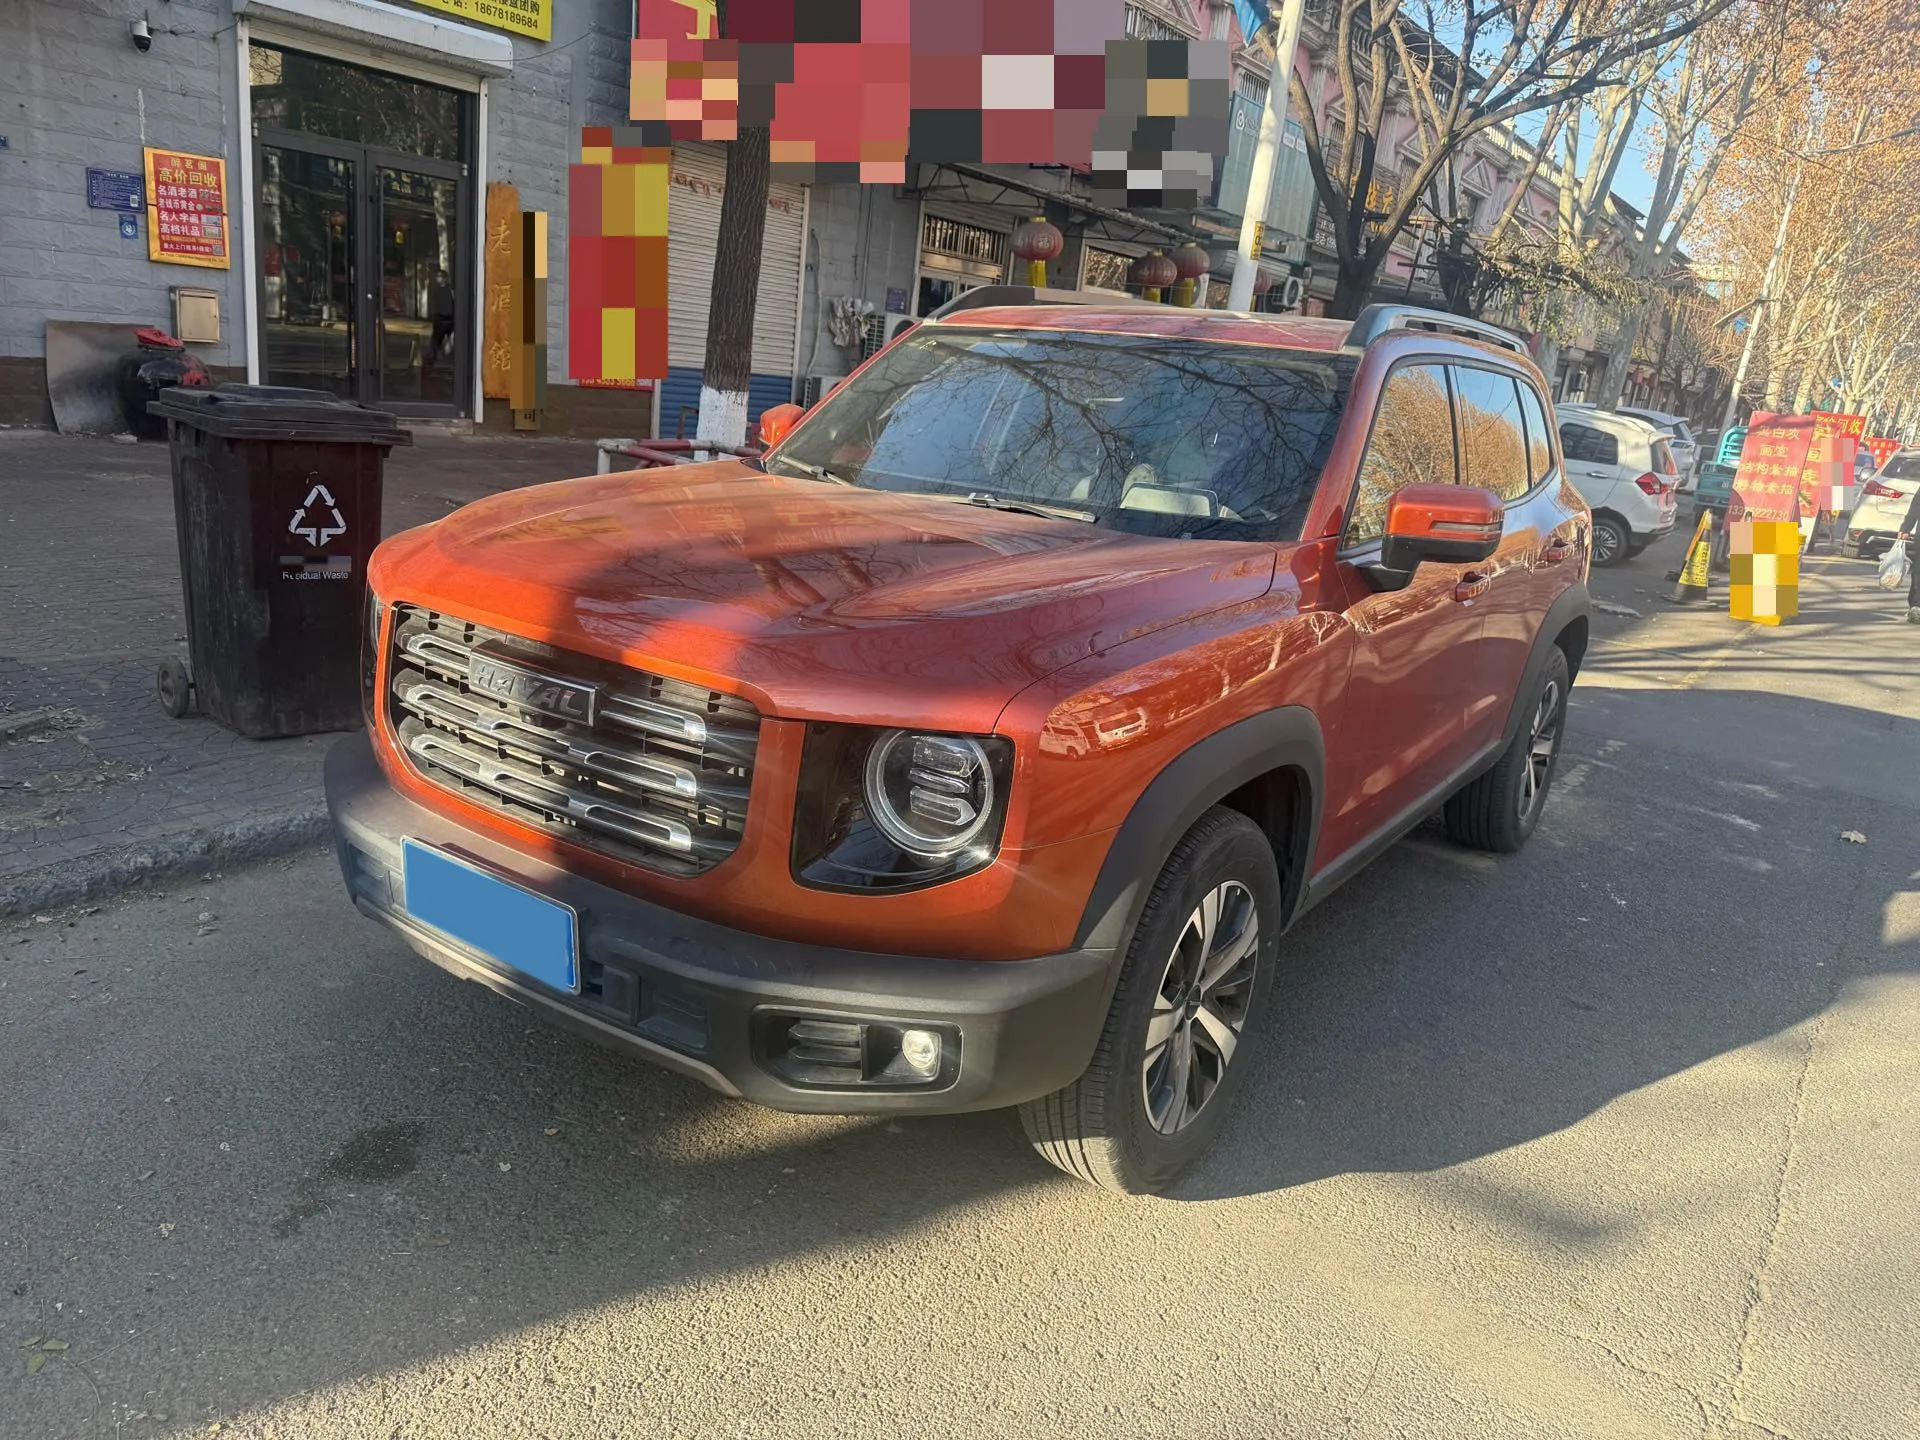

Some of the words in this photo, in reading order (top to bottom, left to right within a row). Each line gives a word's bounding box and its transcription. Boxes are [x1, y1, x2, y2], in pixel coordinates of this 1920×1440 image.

[159, 168, 218, 188] 高价回收
[158, 185, 198, 199] 名酒老酒
[160, 210, 199, 224] 名人字画
[160, 223, 200, 236] 高档礼品
[474, 665, 583, 715] HAVAL
